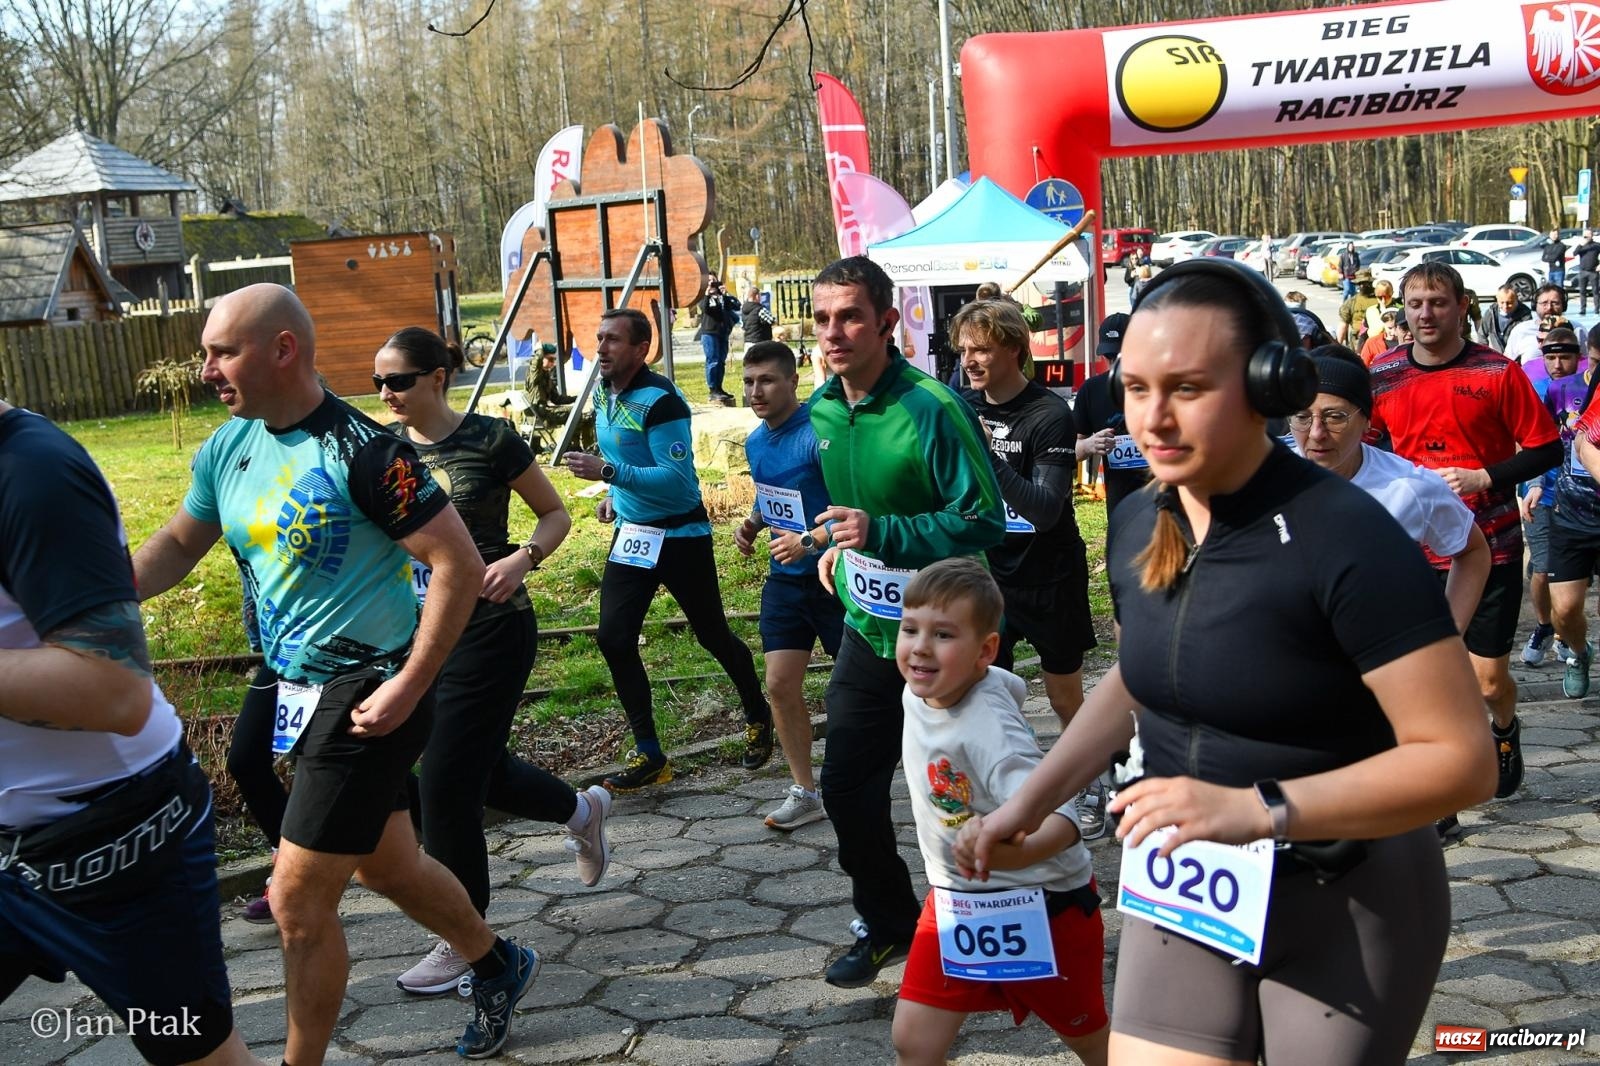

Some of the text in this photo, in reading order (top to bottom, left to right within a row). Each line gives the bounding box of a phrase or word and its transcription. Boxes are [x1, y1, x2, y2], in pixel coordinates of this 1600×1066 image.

[1321, 15, 1410, 40] BIEG
[1251, 42, 1491, 86] TWARDZIELA
[1274, 83, 1467, 123] RACIBÓRZ
[1045, 365, 1064, 382] 14
[767, 500, 794, 519] 105
[623, 539, 651, 556] 093
[854, 572, 902, 604] 056
[1146, 847, 1240, 913] 020
[952, 898, 972, 909] BIEG
[973, 895, 1034, 909] TWARDZIELA
[954, 923, 1027, 958] 065
